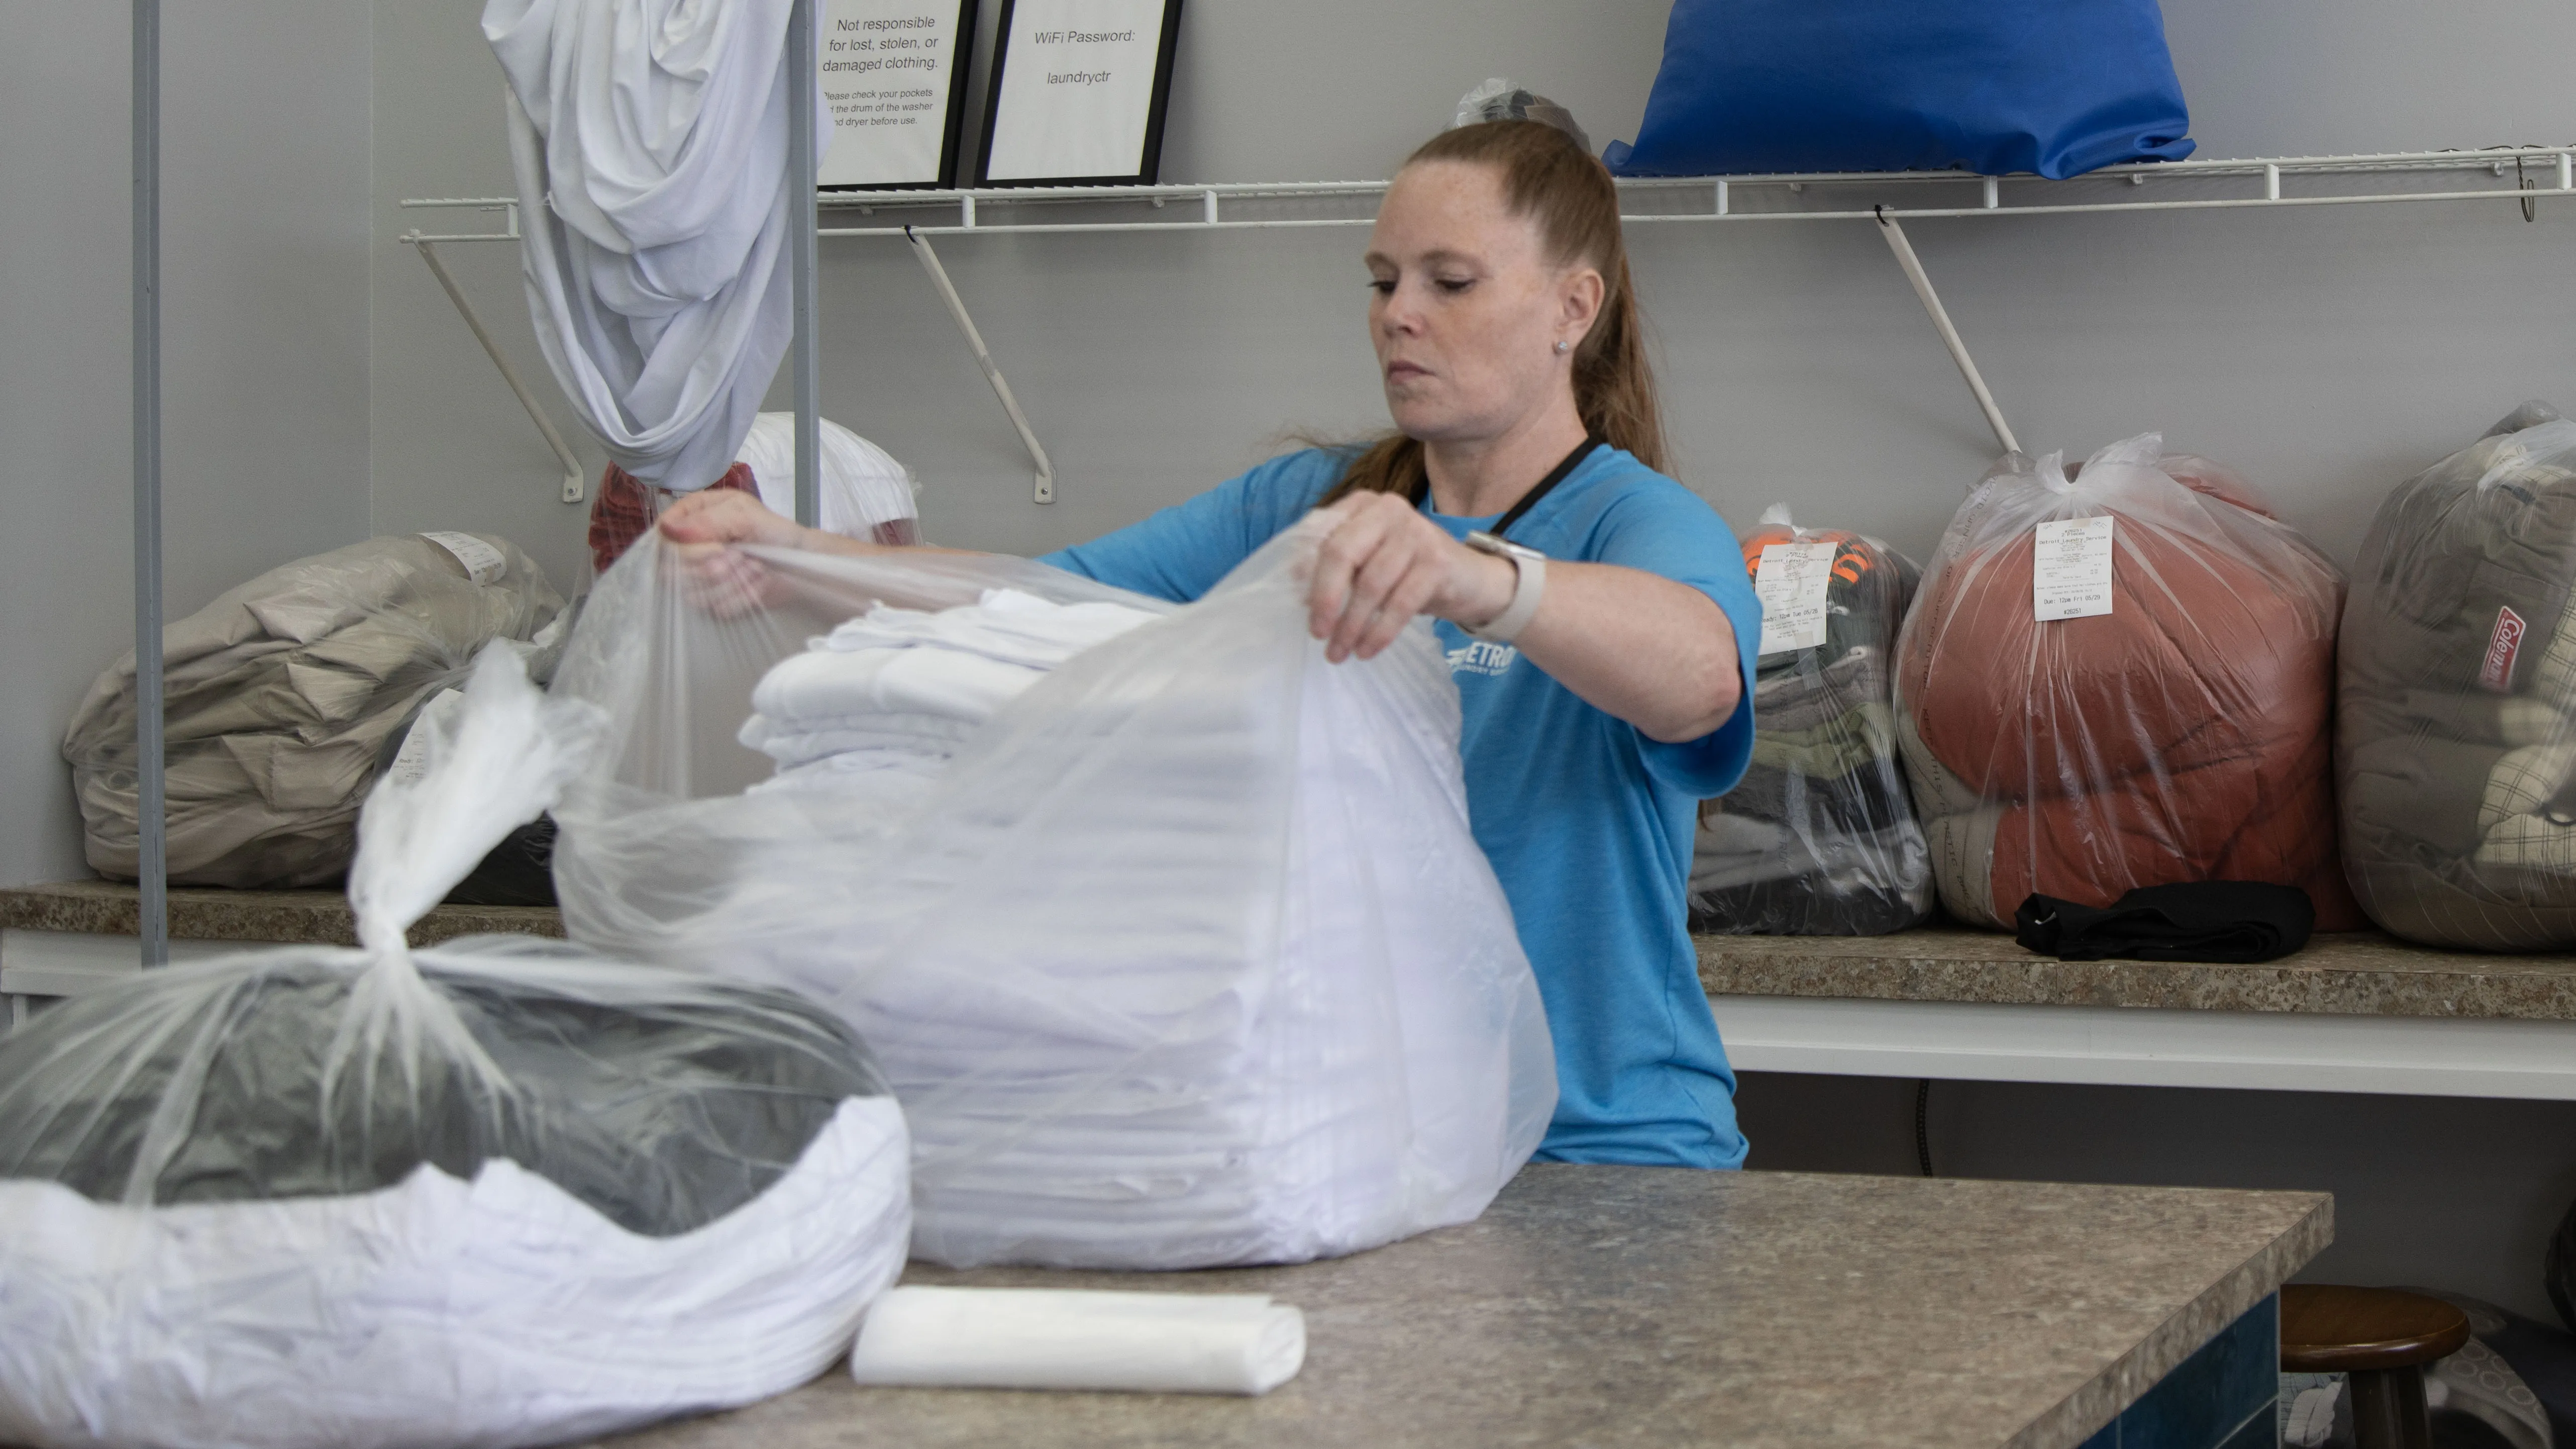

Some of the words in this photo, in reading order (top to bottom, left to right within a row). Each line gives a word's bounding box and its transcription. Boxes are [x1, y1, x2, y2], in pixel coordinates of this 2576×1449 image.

[837, 19, 860, 31] Not
[863, 17, 935, 32] responsible
[829, 40, 847, 51] for
[850, 39, 875, 52] lost,
[880, 37, 920, 50] stolen,
[925, 38, 939, 48] or
[1035, 32, 1064, 44] WiFi
[1068, 30, 1136, 43] Password:
[823, 58, 882, 73] damaged
[885, 56, 938, 72] clothing.
[1048, 71, 1111, 86] laundryctr
[852, 90, 876, 99] check
[879, 90, 898, 100] your
[900, 88, 933, 100] pockets
[836, 105, 848, 113] the
[851, 104, 873, 113] drum
[875, 104, 884, 112] of
[886, 104, 899, 112] the
[902, 103, 934, 111] washer
[846, 118, 868, 128] dryer
[871, 117, 898, 126] before
[1465, 641, 1517, 668] ETRO
